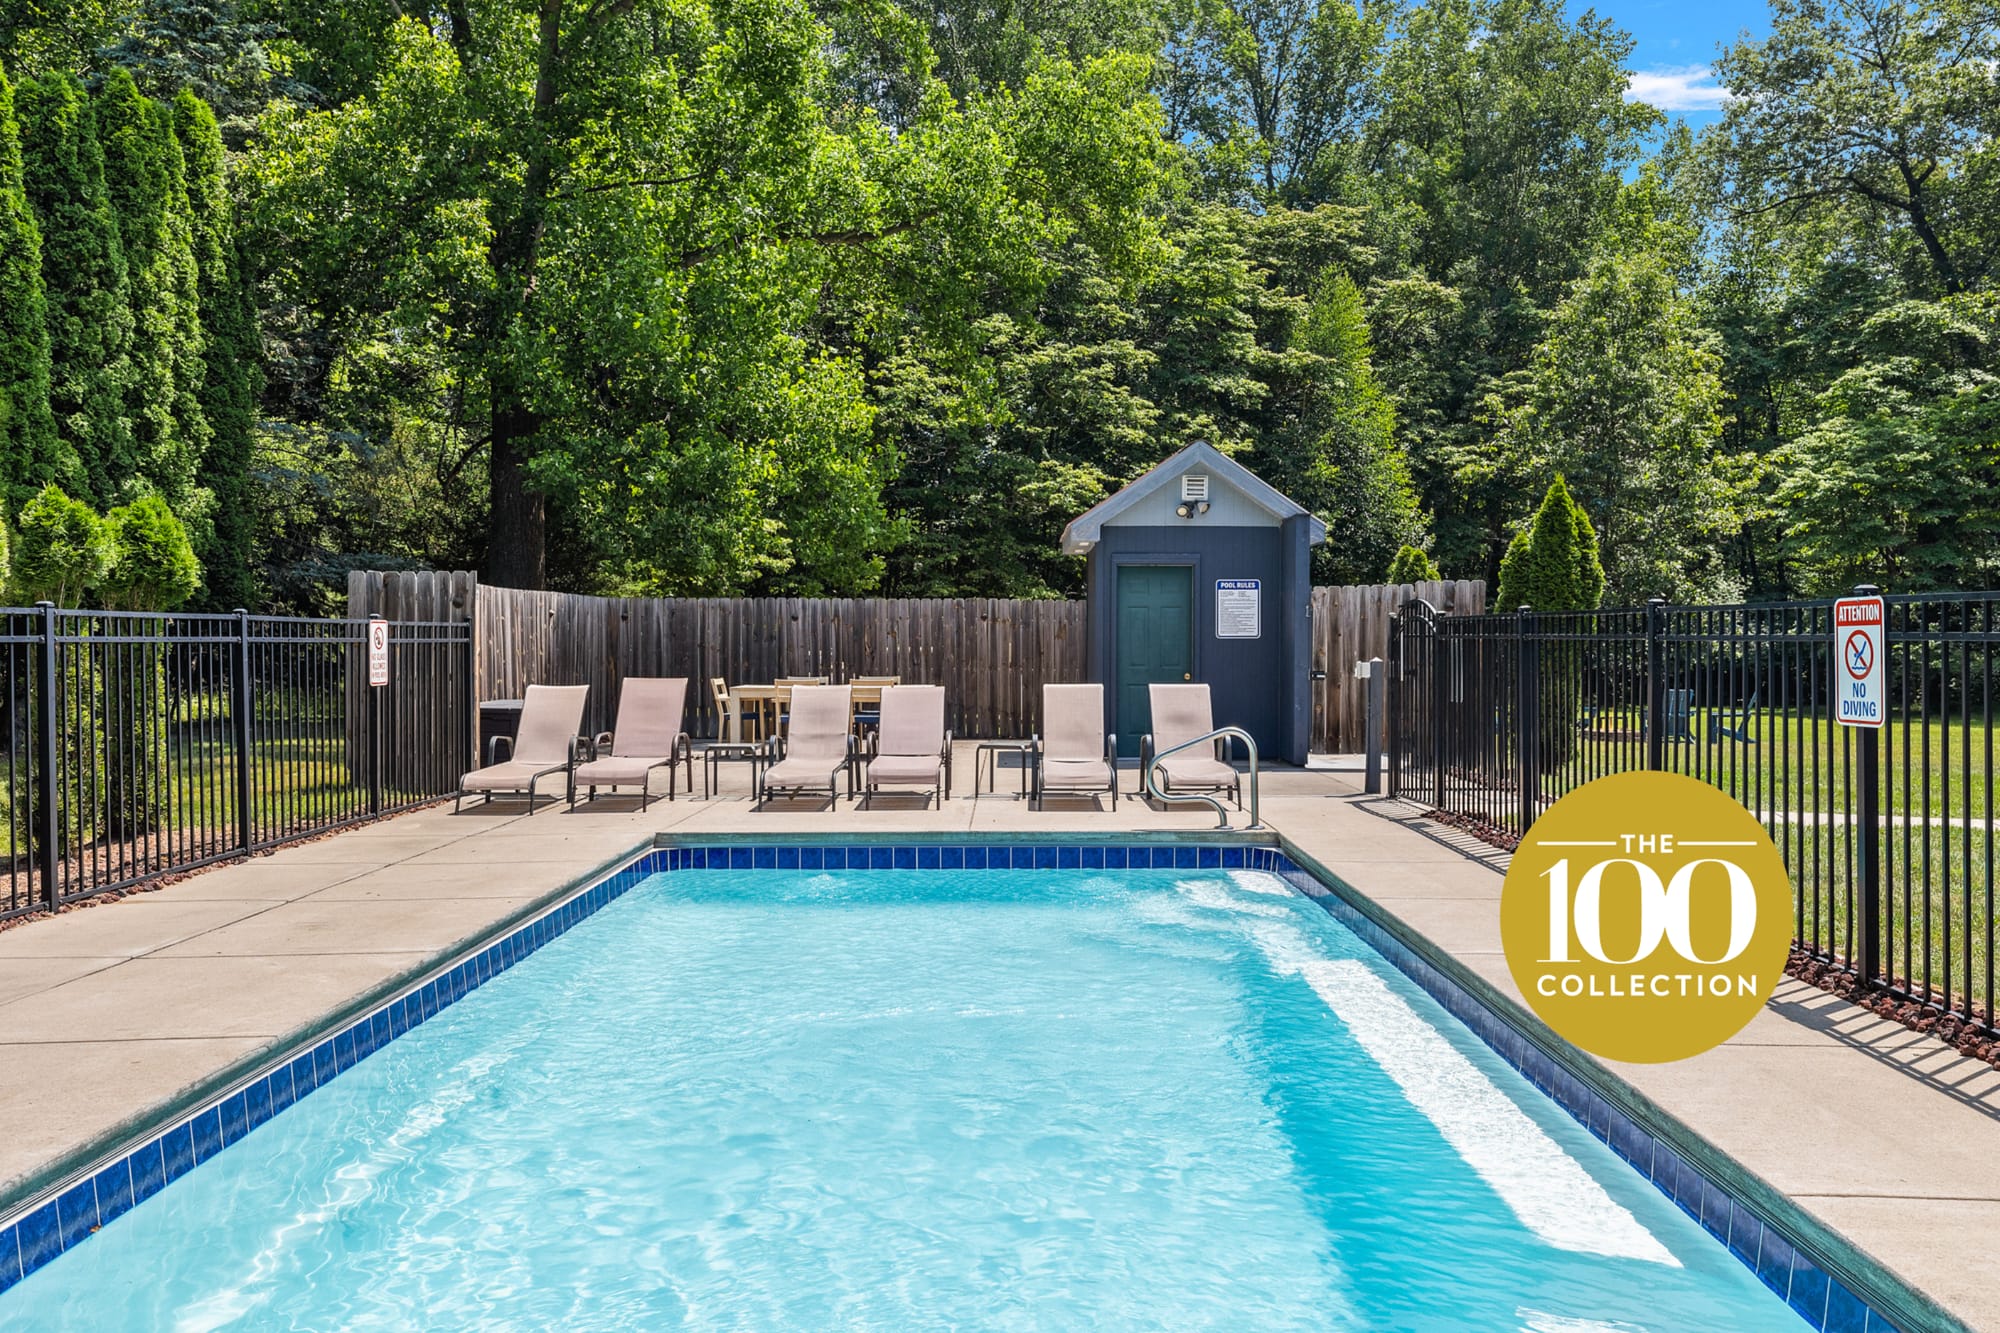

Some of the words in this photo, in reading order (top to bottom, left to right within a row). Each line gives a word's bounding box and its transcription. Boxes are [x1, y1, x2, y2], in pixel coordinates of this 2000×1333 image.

[1839, 603, 1880, 622] ATTENTION
[1852, 682, 1866, 698] NO
[1843, 700, 1877, 717] DIVING
